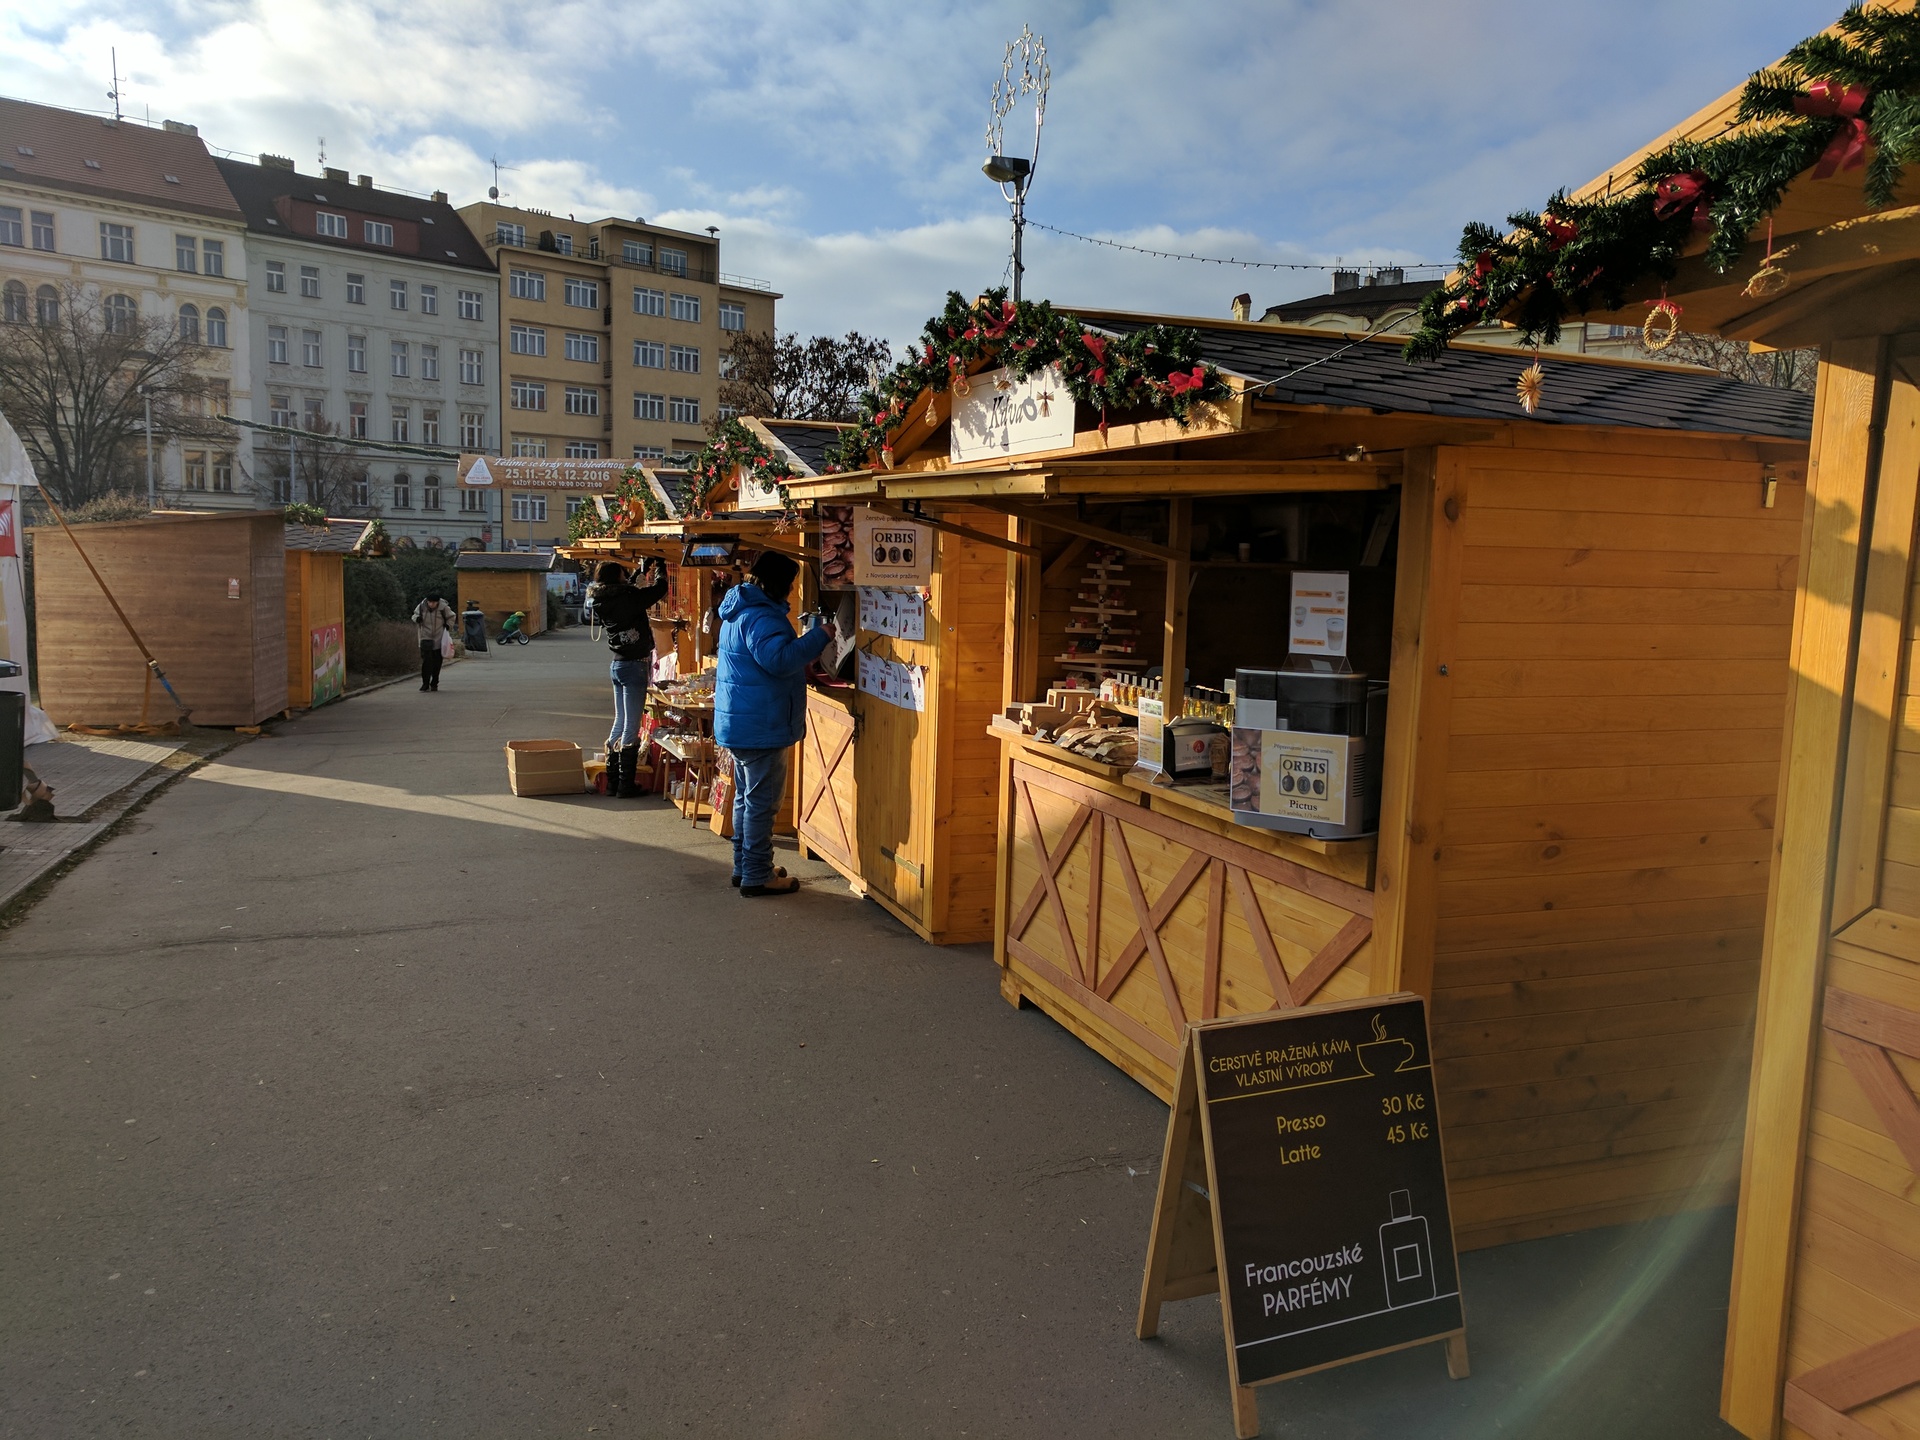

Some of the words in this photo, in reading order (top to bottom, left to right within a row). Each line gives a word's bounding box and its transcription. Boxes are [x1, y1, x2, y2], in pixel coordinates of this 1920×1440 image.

[582, 470, 610, 481] 2016
[875, 532, 914, 544] ORBIS
[1283, 759, 1326, 774] ORBIS
[1289, 799, 1318, 811] Pictus
[1209, 1051, 1263, 1073] ČERSTVĚ
[1266, 1041, 1319, 1064] PRAŽENÁ
[1322, 1039, 1351, 1055] KÁVA
[1235, 1066, 1284, 1088] VLASTNÍ
[1286, 1060, 1335, 1079] VÝROBY
[1276, 1114, 1326, 1135] Presso
[1382, 1096, 1401, 1116] 30
[1406, 1094, 1425, 1112] Kč
[1280, 1144, 1321, 1165] Latte
[1387, 1125, 1406, 1144] 45
[1411, 1122, 1429, 1141] Kč
[1245, 1242, 1364, 1287] Francouzské
[1262, 1274, 1353, 1317] PARFÉMY
